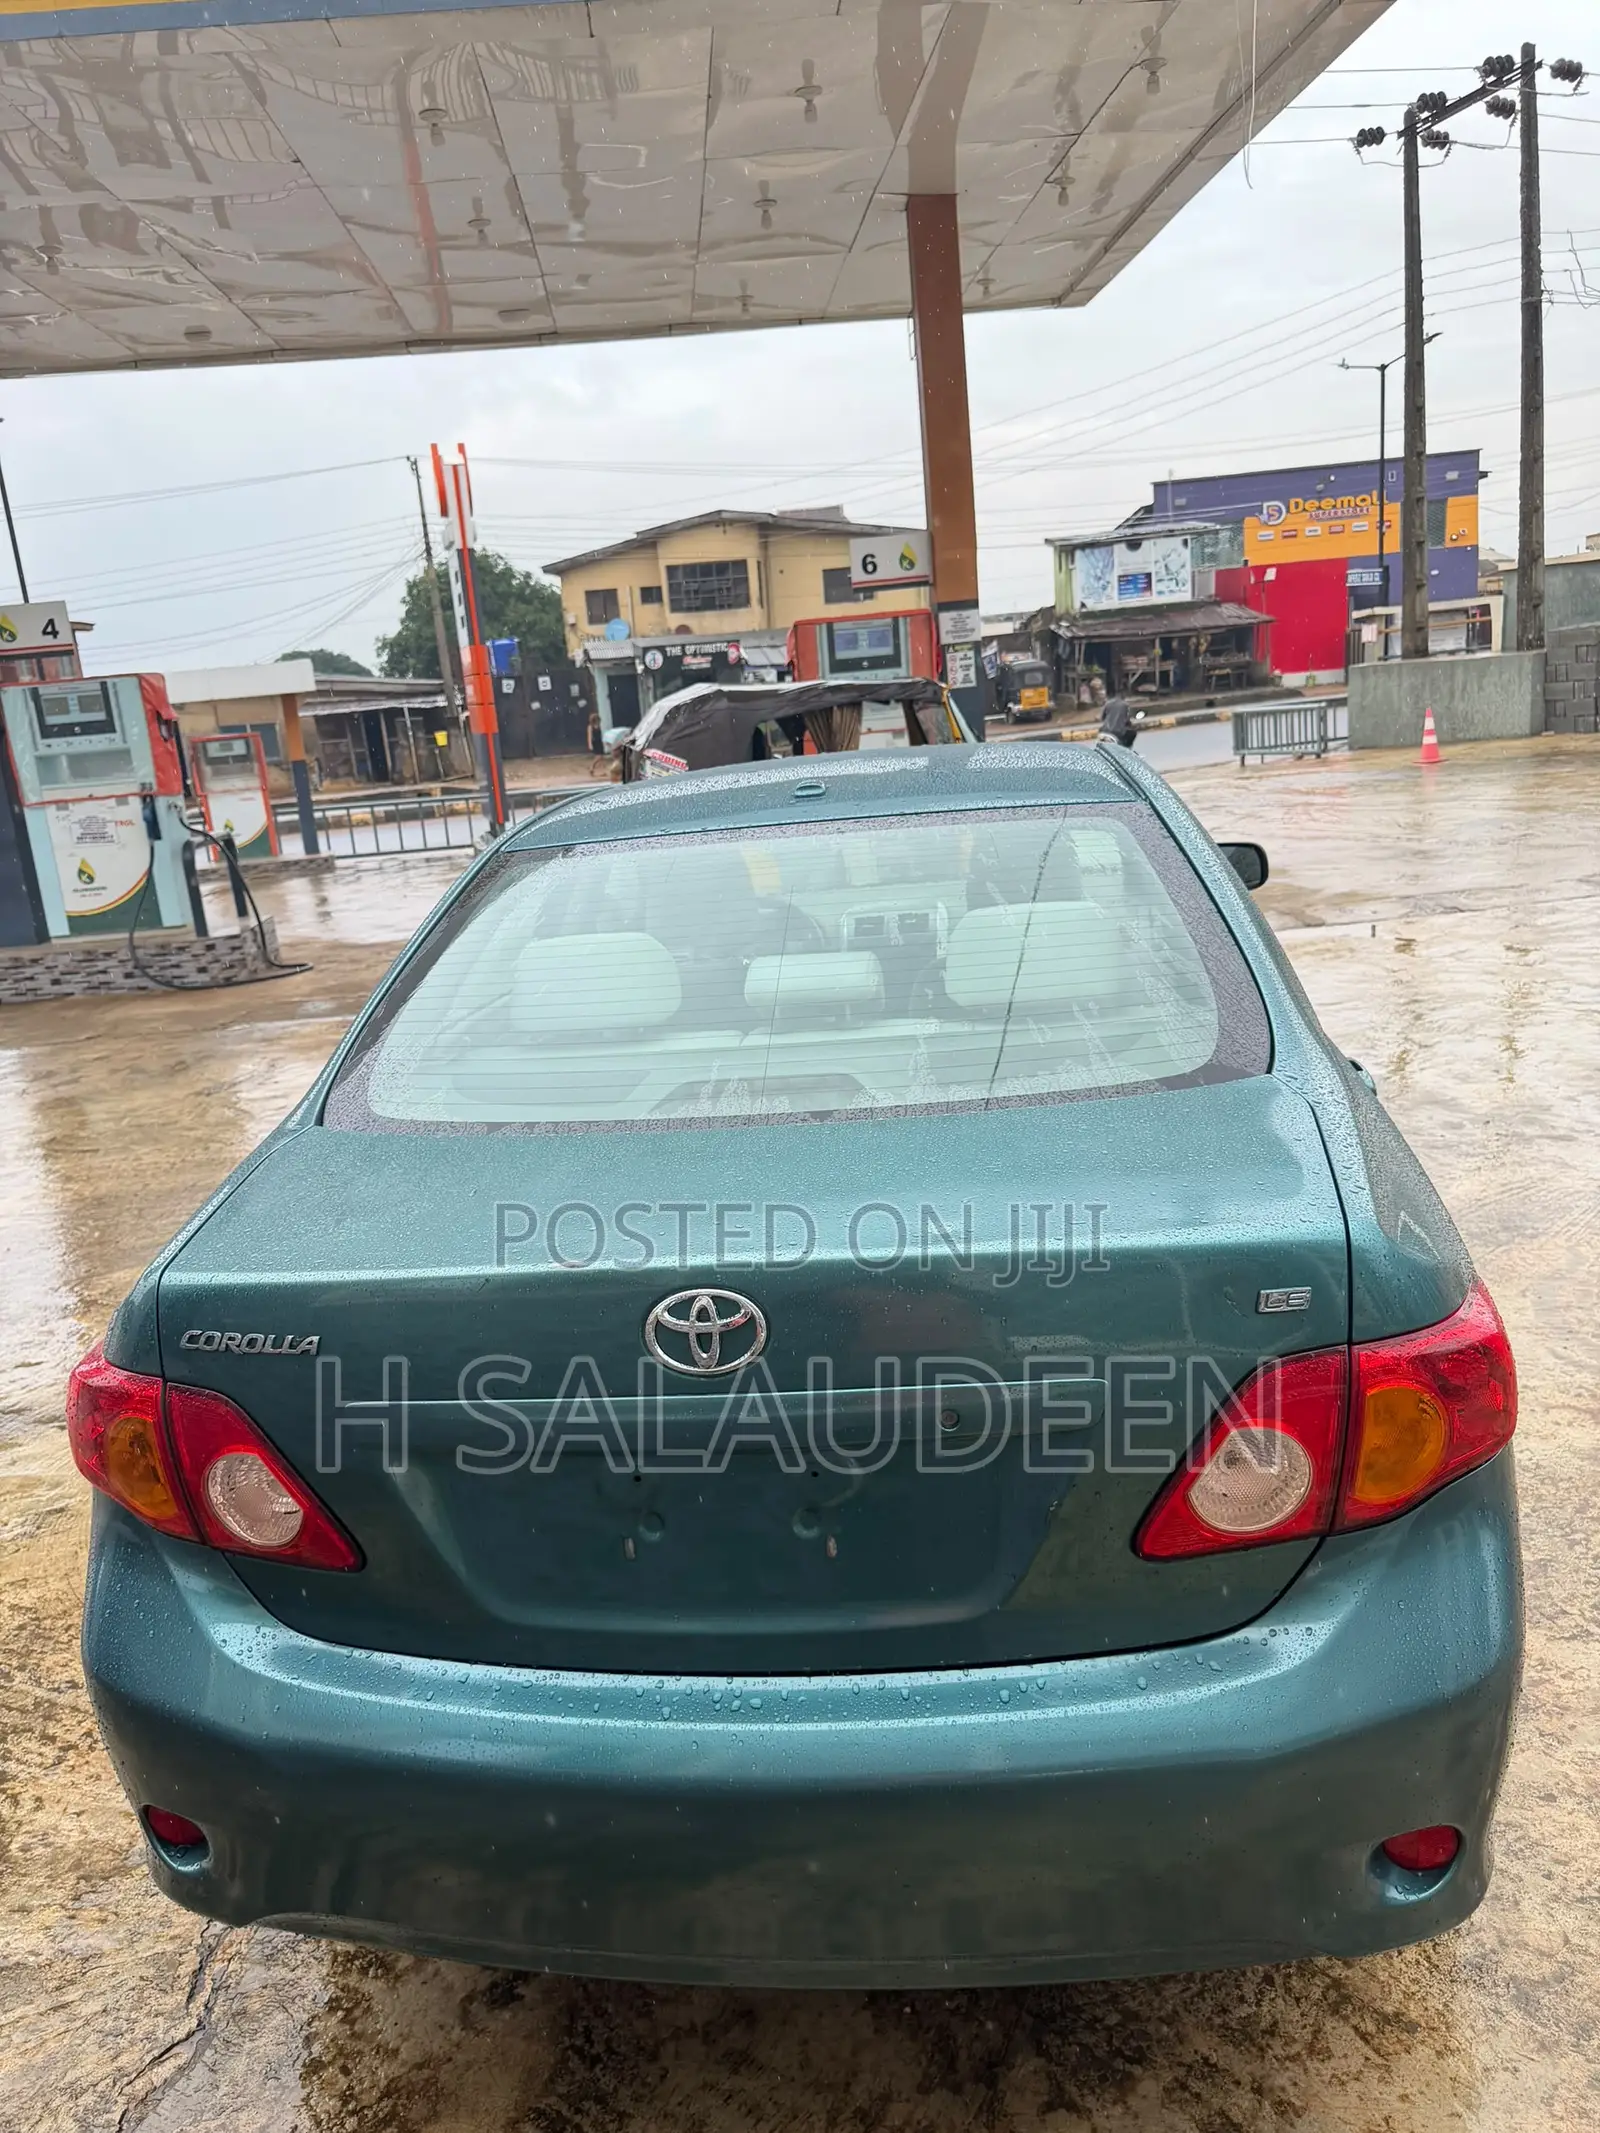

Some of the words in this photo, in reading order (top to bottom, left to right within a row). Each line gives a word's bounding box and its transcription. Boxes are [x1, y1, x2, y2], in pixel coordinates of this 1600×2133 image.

[862, 553, 877, 575] 6
[42, 618, 59, 639] 4
[665, 646, 683, 657] THE
[180, 1330, 320, 1355] COROLLA
